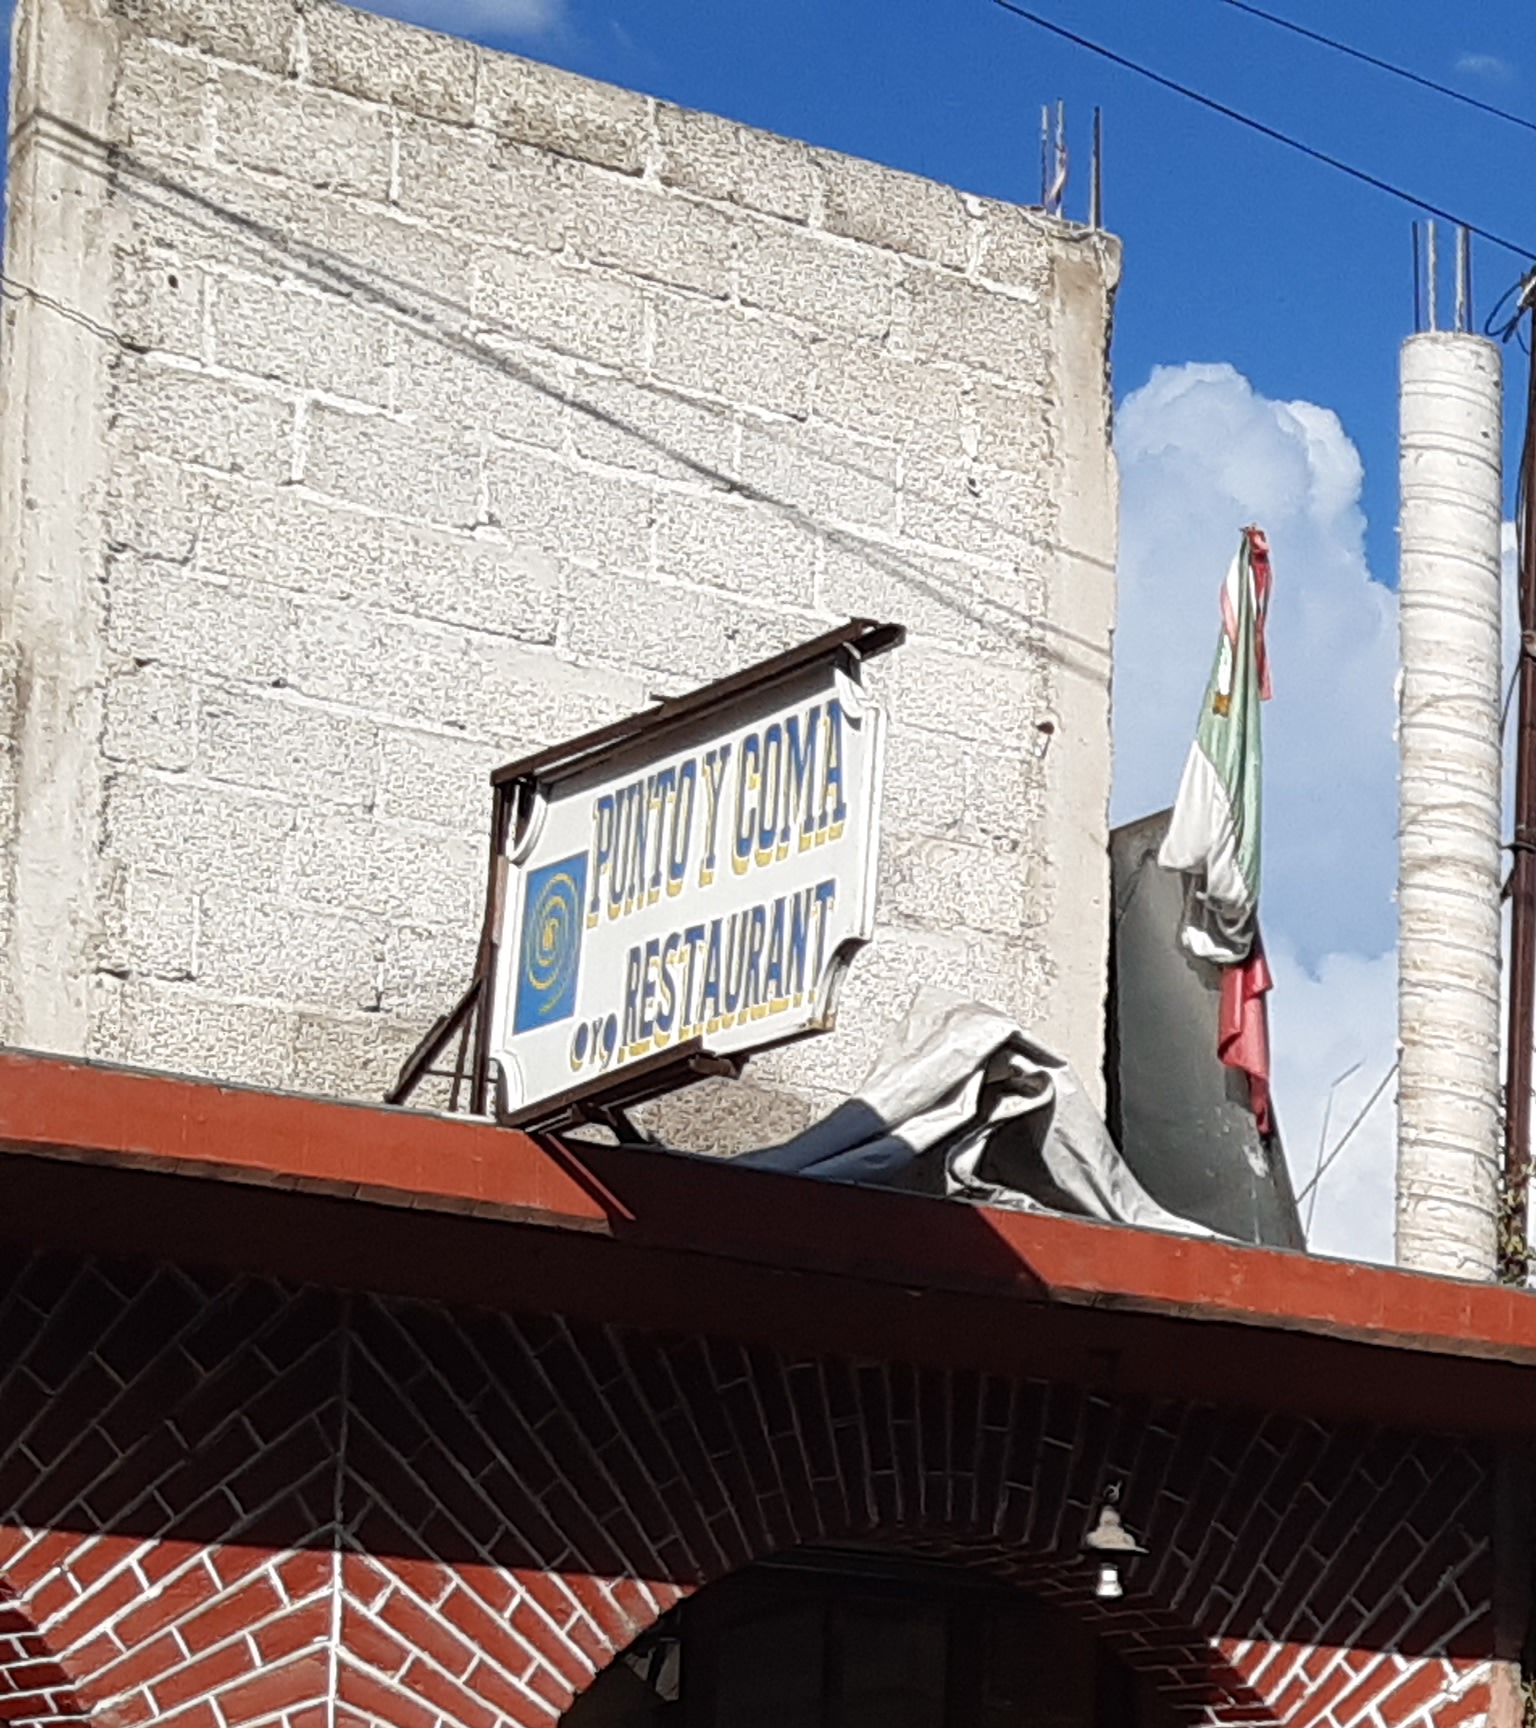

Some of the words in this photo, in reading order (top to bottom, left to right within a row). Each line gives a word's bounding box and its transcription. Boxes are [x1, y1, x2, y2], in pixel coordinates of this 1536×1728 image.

[587, 757, 697, 929] PUNTO
[699, 743, 732, 888] Y
[732, 698, 847, 875] COMA
[618, 878, 836, 1064] RESTAURANT
